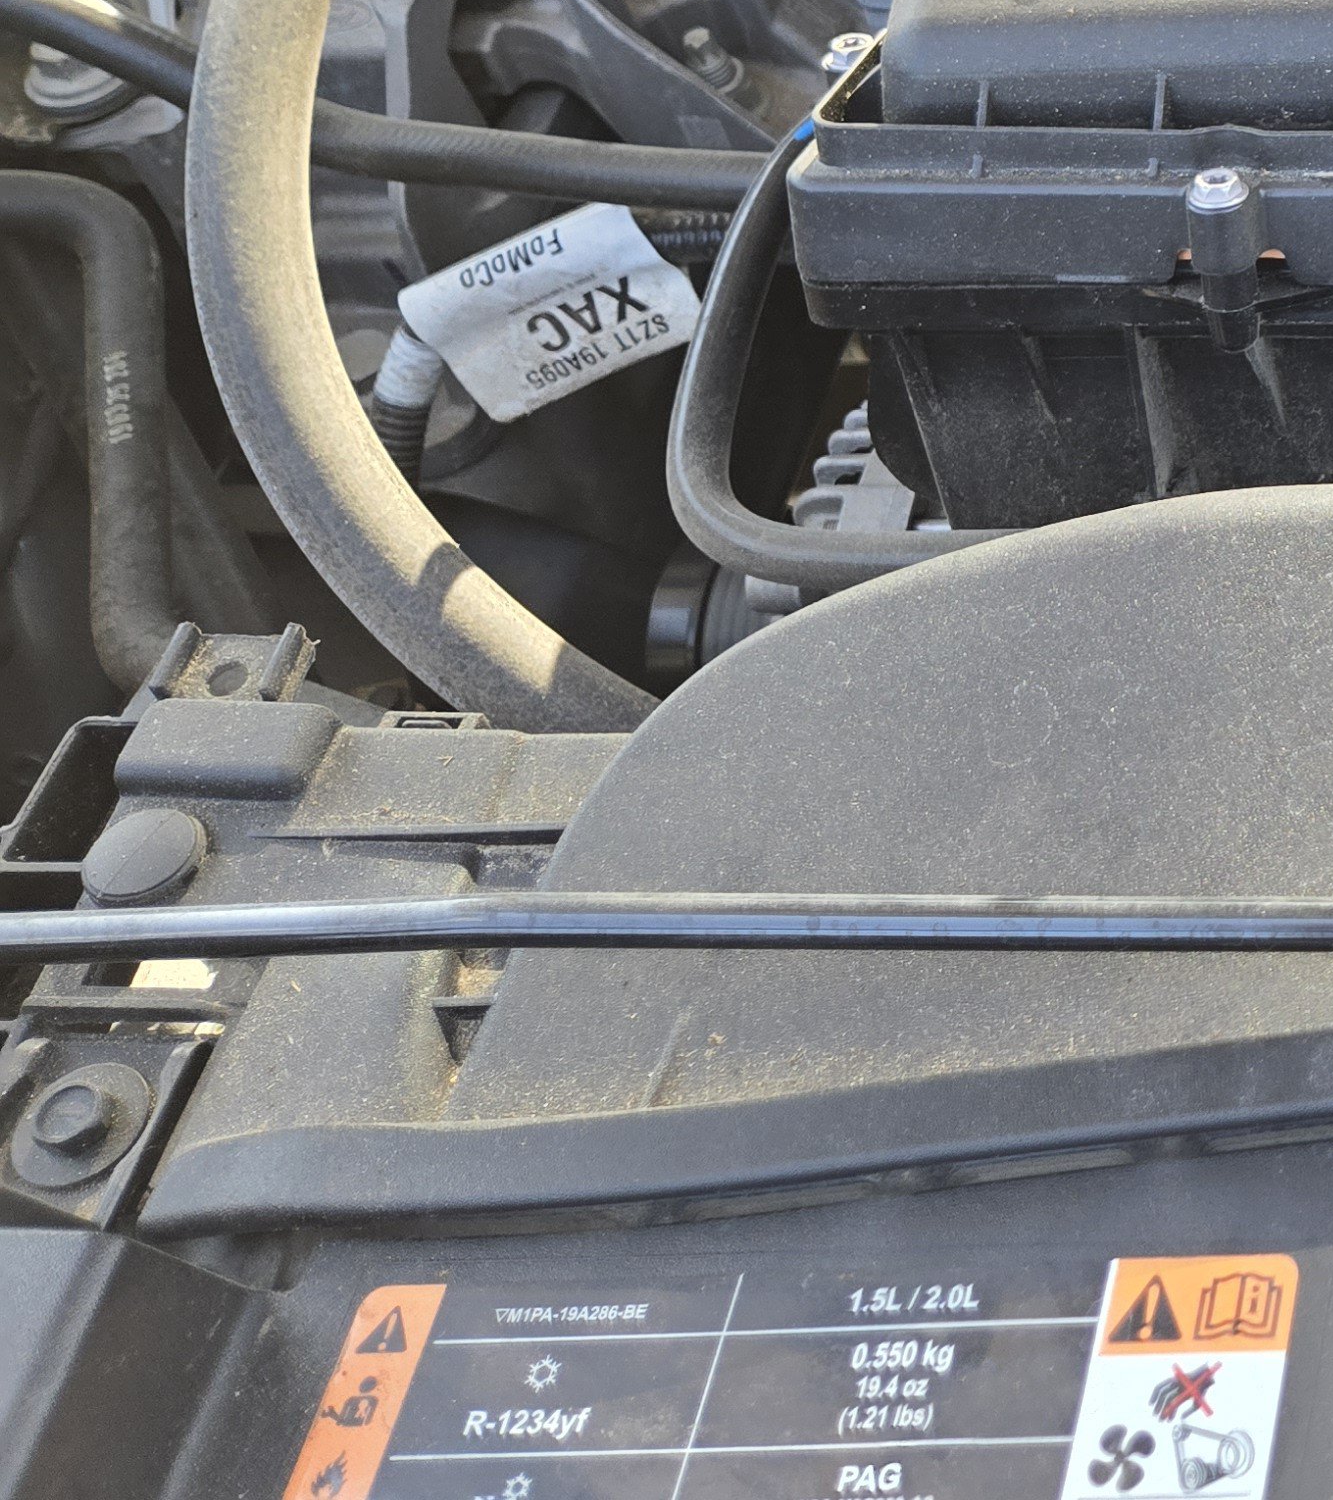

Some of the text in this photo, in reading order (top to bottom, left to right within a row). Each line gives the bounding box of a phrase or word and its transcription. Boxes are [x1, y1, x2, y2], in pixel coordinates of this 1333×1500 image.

[459, 228, 564, 289] FoMoCo
[528, 276, 648, 352] XAC
[525, 341, 609, 390] 19A095
[848, 1286, 902, 1313] 1.5L
[923, 1284, 980, 1309] 2.0L
[851, 1340, 955, 1375] 0.550 kg
[855, 1376, 930, 1399] 19.4 oz
[462, 1406, 592, 1440] R-1234yf
[838, 1404, 934, 1436] (1.21 lbs)
[837, 1462, 903, 1492] PAG
